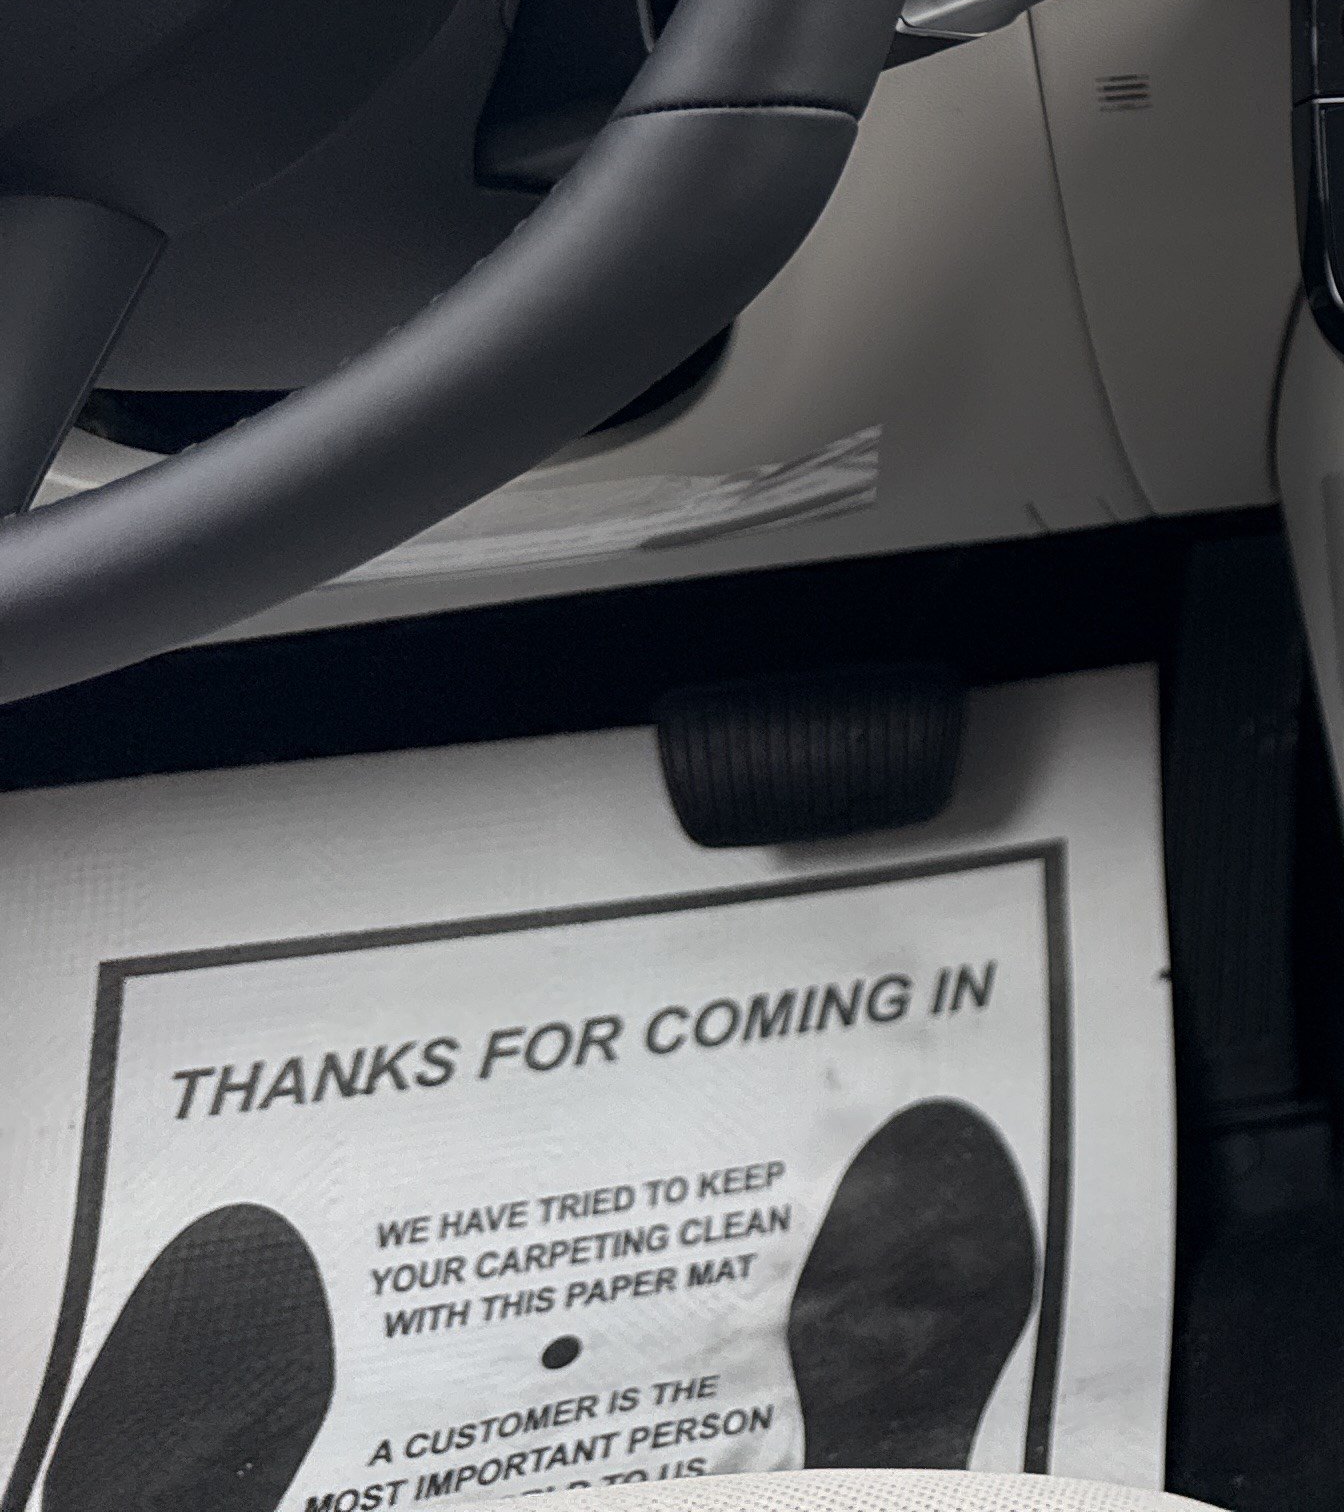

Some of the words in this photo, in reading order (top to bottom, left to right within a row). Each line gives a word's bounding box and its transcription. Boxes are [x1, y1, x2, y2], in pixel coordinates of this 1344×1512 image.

[172, 1035, 460, 1120] THANKS
[478, 1014, 622, 1081] FOR
[646, 972, 911, 1057] COMING
[931, 960, 998, 1016] IN
[370, 1254, 467, 1296] YOUR
[475, 1222, 671, 1280] CARPETING
[677, 1202, 793, 1246] CLEAN
[377, 1214, 431, 1249] WE
[438, 1199, 531, 1240] HAVE
[538, 1185, 636, 1225] TRIED
[641, 1175, 690, 1207] TO
[697, 1159, 788, 1199] KEEP
[383, 1299, 471, 1338] WITH
[482, 1285, 557, 1323] THIS
[564, 1265, 679, 1309] PAPER
[686, 1251, 759, 1288] MAT
[303, 1478, 409, 1512] MOST
[413, 1431, 619, 1501] IMPORTANT
[626, 1403, 775, 1455] PERSON
[365, 1438, 395, 1468] A
[403, 1391, 600, 1462] CUSTOMER
[608, 1385, 641, 1417] IS
[651, 1373, 721, 1408] THE
